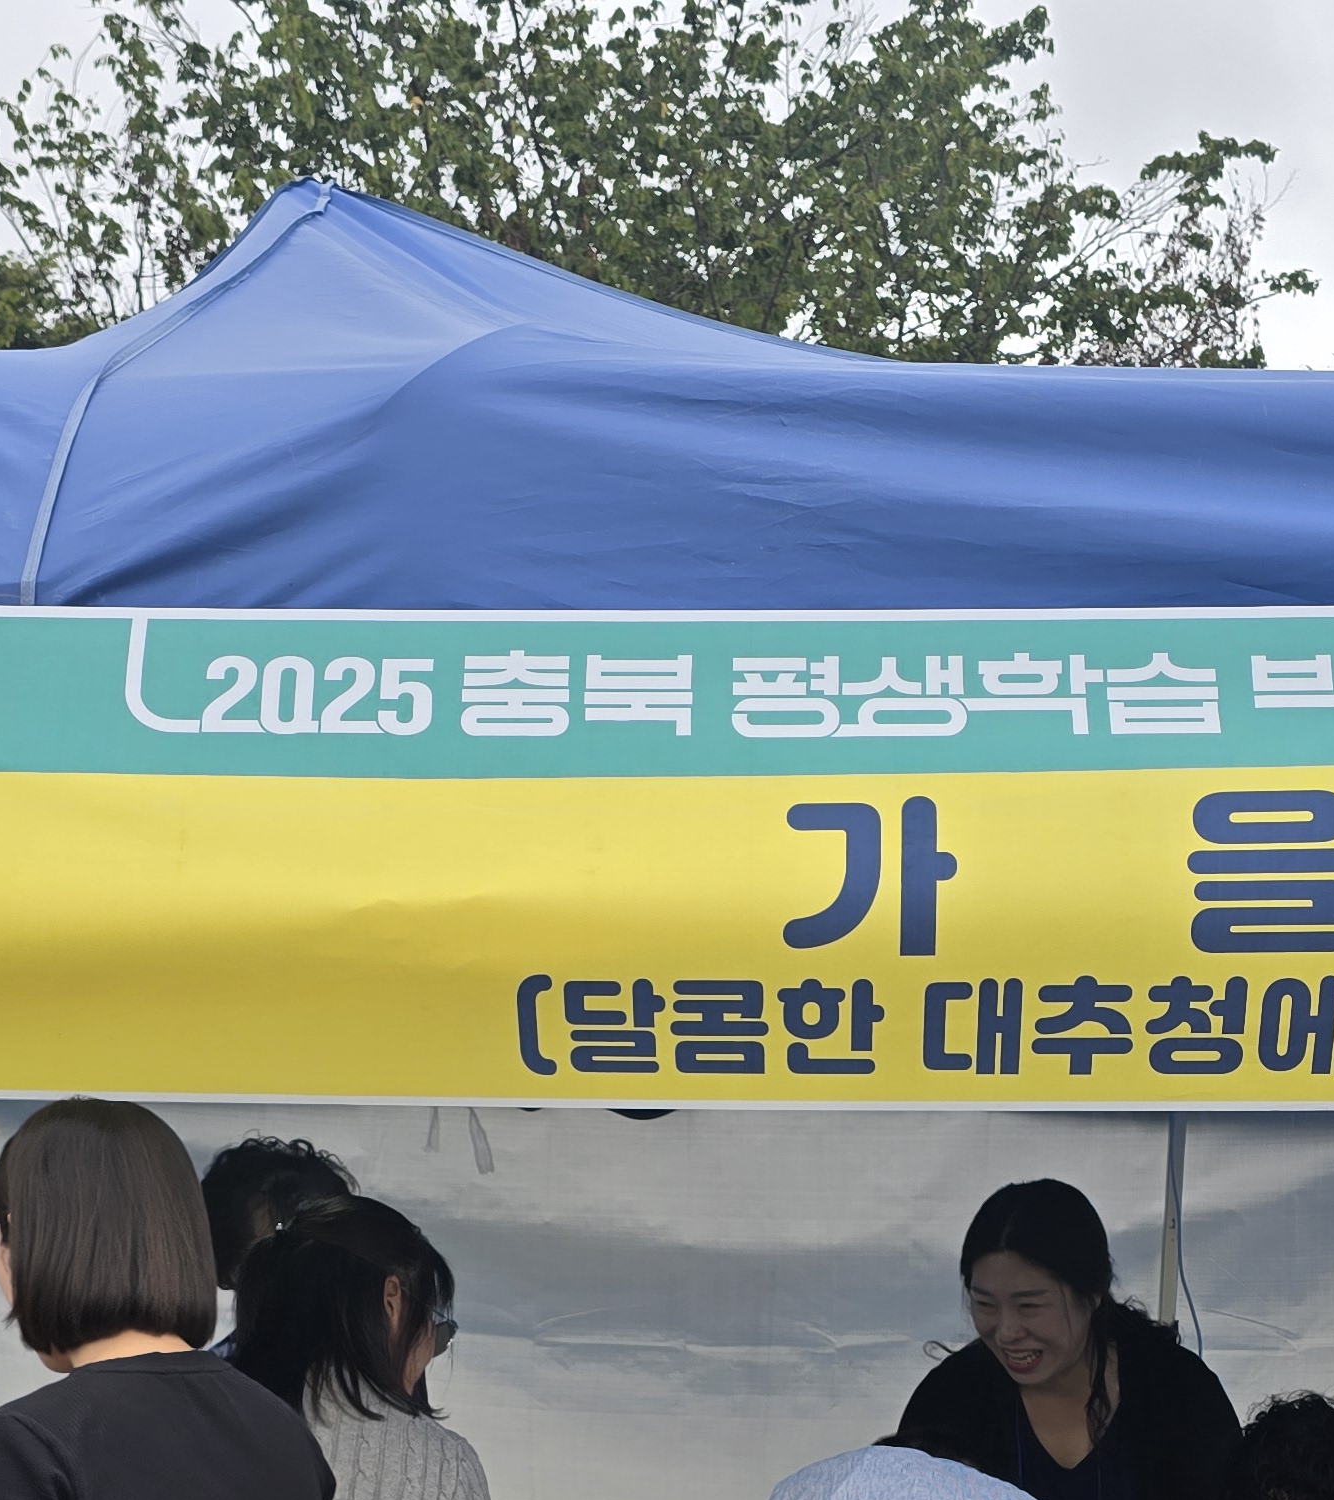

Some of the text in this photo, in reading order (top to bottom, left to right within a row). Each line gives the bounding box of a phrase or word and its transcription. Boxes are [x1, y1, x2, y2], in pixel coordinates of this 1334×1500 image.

[199, 655, 435, 737] 2025
[459, 649, 694, 737] 충북
[730, 652, 1222, 738] 평생학습
[516, 973, 886, 1076] (달콤한
